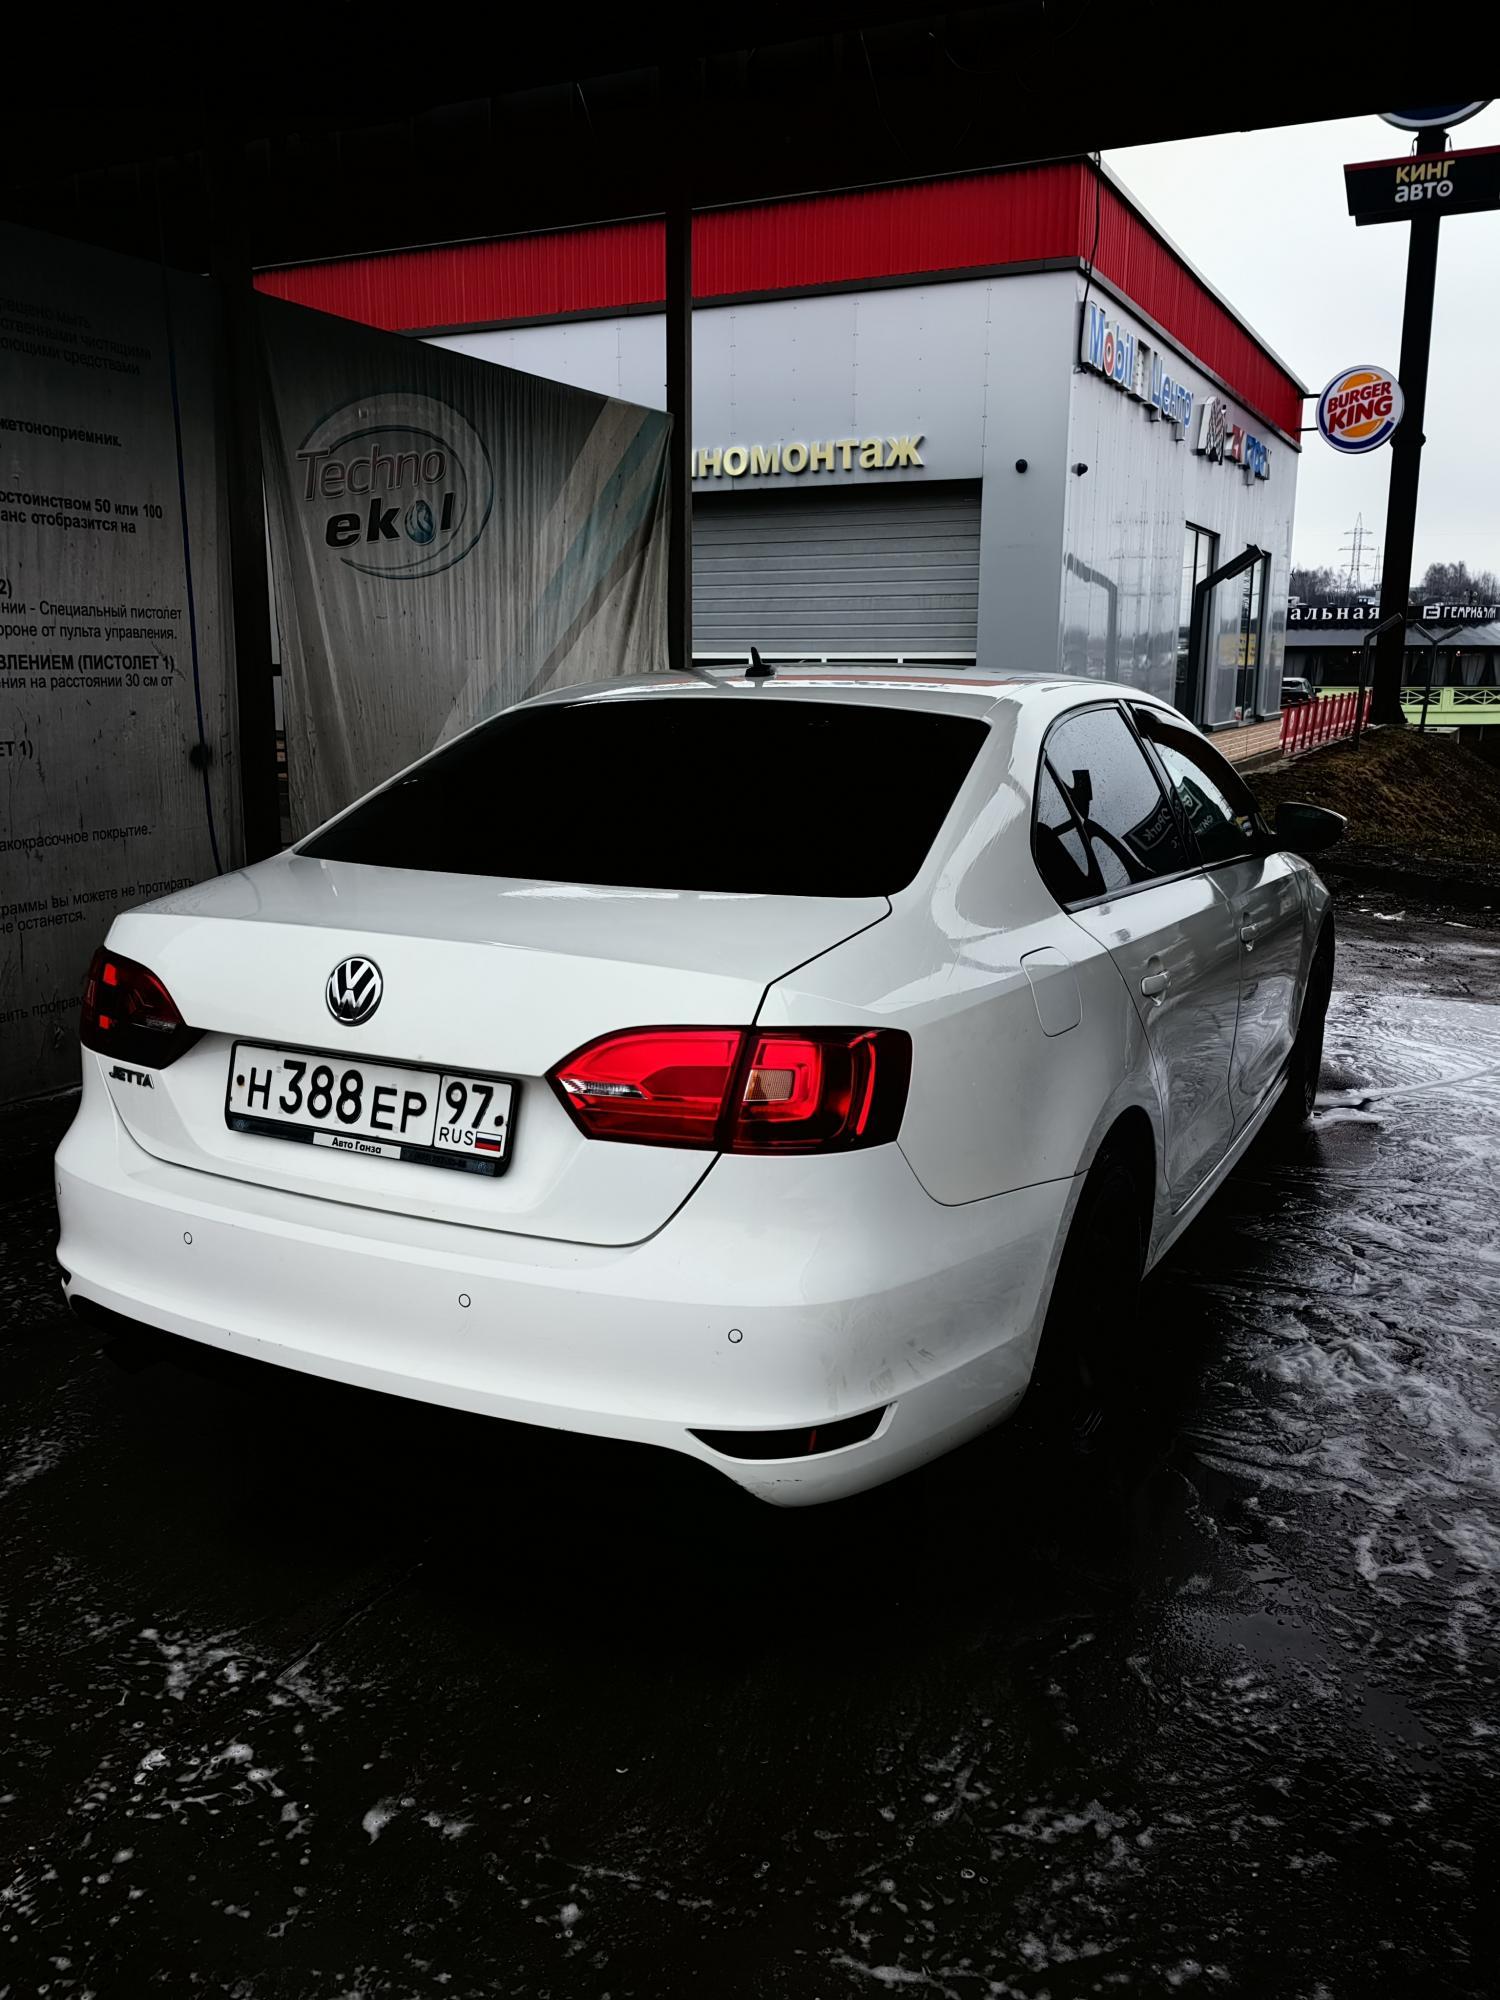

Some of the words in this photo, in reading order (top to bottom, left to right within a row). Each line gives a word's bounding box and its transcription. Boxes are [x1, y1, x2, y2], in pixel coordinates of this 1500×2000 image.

[1395, 160, 1456, 184] КИНГ
[1394, 180, 1454, 203] авто
[1088, 301, 1136, 391] Mobil
[1151, 351, 1194, 428] Центр
[1327, 381, 1392, 414] BURGER
[1328, 396, 1393, 434] KING
[296, 443, 446, 501] Techno
[95, 498, 111, 514] 50
[114, 503, 138, 517] или
[143, 504, 163, 519] 100
[31, 512, 118, 532] отобразится
[120, 521, 137, 533] на
[39, 600, 127, 618] Специальный
[130, 607, 182, 620] пистолет
[1290, 606, 1381, 621] альная
[41, 625, 56, 637] от
[60, 625, 101, 640] пульта
[104, 627, 178, 641] управления.
[78, 654, 159, 674] (ПИСТОЛЕТ
[162, 655, 174, 673] 1)
[0, 676, 26, 689] ния
[30, 677, 47, 689] на
[50, 675, 123, 691] расстоянии
[125, 673, 140, 687] 30
[143, 676, 158, 687] см
[161, 675, 174, 687] от
[19, 740, 33, 759] 1)
[92, 824, 152, 842] покрытие.
[51, 896, 69, 909] вы
[73, 887, 119, 905] можете
[121, 885, 136, 897] не
[138, 877, 195, 897] протирать
[17, 910, 86, 932] останется.
[108, 1065, 155, 1090] JETTA
[445, 1081, 494, 1129] 97
[331, 1136, 353, 1150] Авто
[355, 1140, 382, 1155] Ганза
[438, 1126, 474, 1146] RUS
